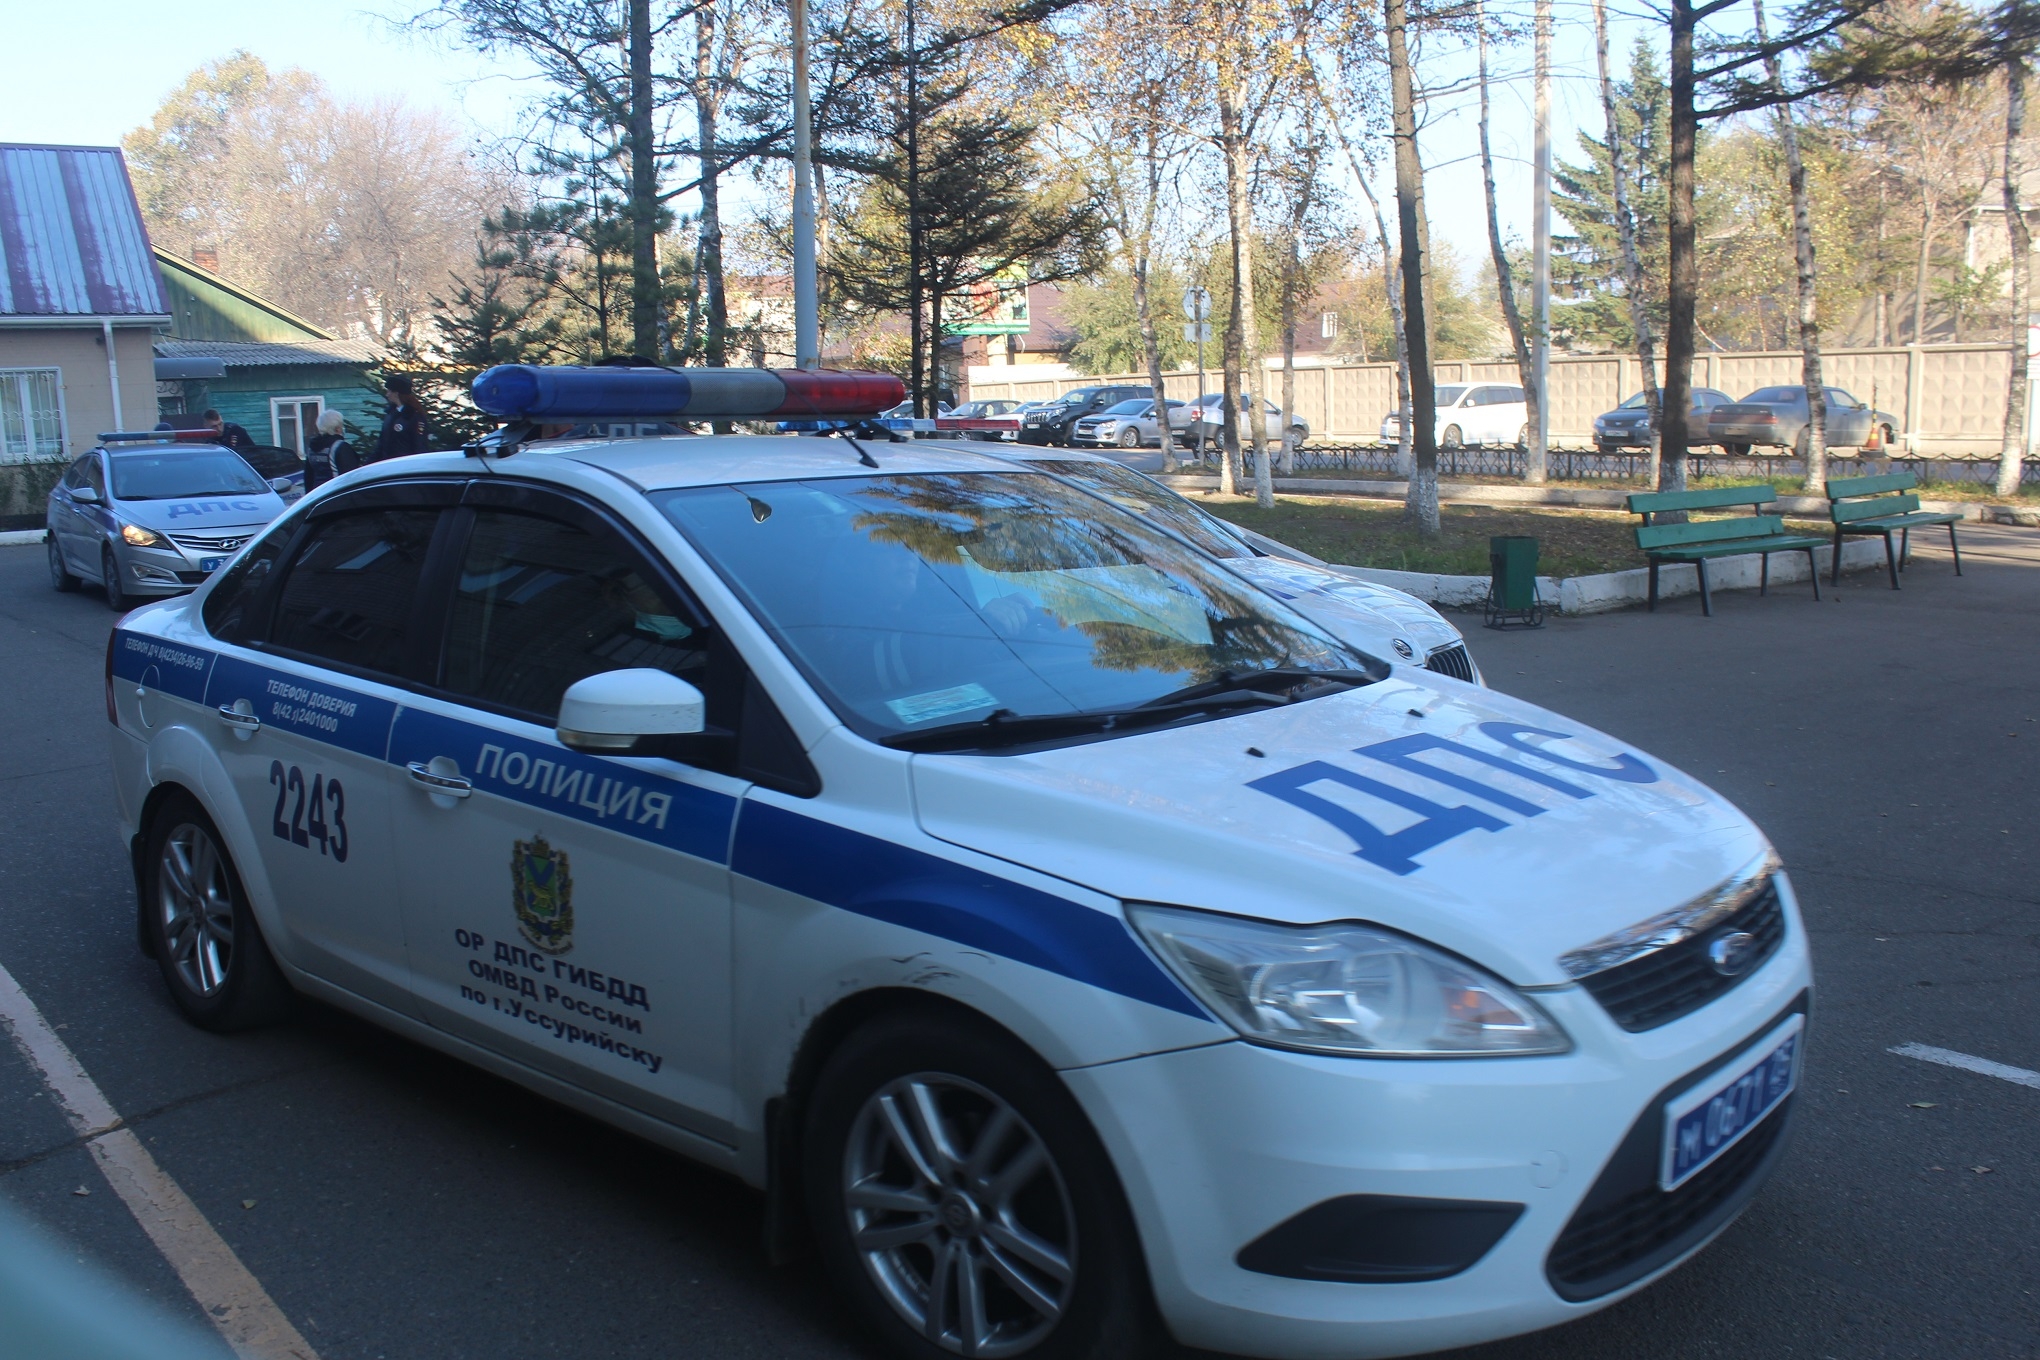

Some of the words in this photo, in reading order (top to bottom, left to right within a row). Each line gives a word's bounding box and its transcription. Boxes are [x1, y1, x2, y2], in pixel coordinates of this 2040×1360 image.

[167, 501, 260, 519] ДПС
[125, 637, 150, 654] ТЕЛЕФОН
[267, 679, 310, 703] ТЕЛЕФОН
[307, 692, 358, 717] ДОВЕРИЯ
[270, 760, 348, 863] 2243
[475, 743, 673, 830] ПОЛИЦИЯ
[1243, 721, 1660, 877] ДПС
[455, 928, 484, 950] ОР
[494, 940, 546, 973] ДПС
[553, 959, 650, 1012] ГИБДД
[468, 959, 538, 1002] ОМВД
[544, 984, 642, 1034] России
[460, 984, 487, 1005] по
[493, 997, 663, 1074] г.Уссурийску
